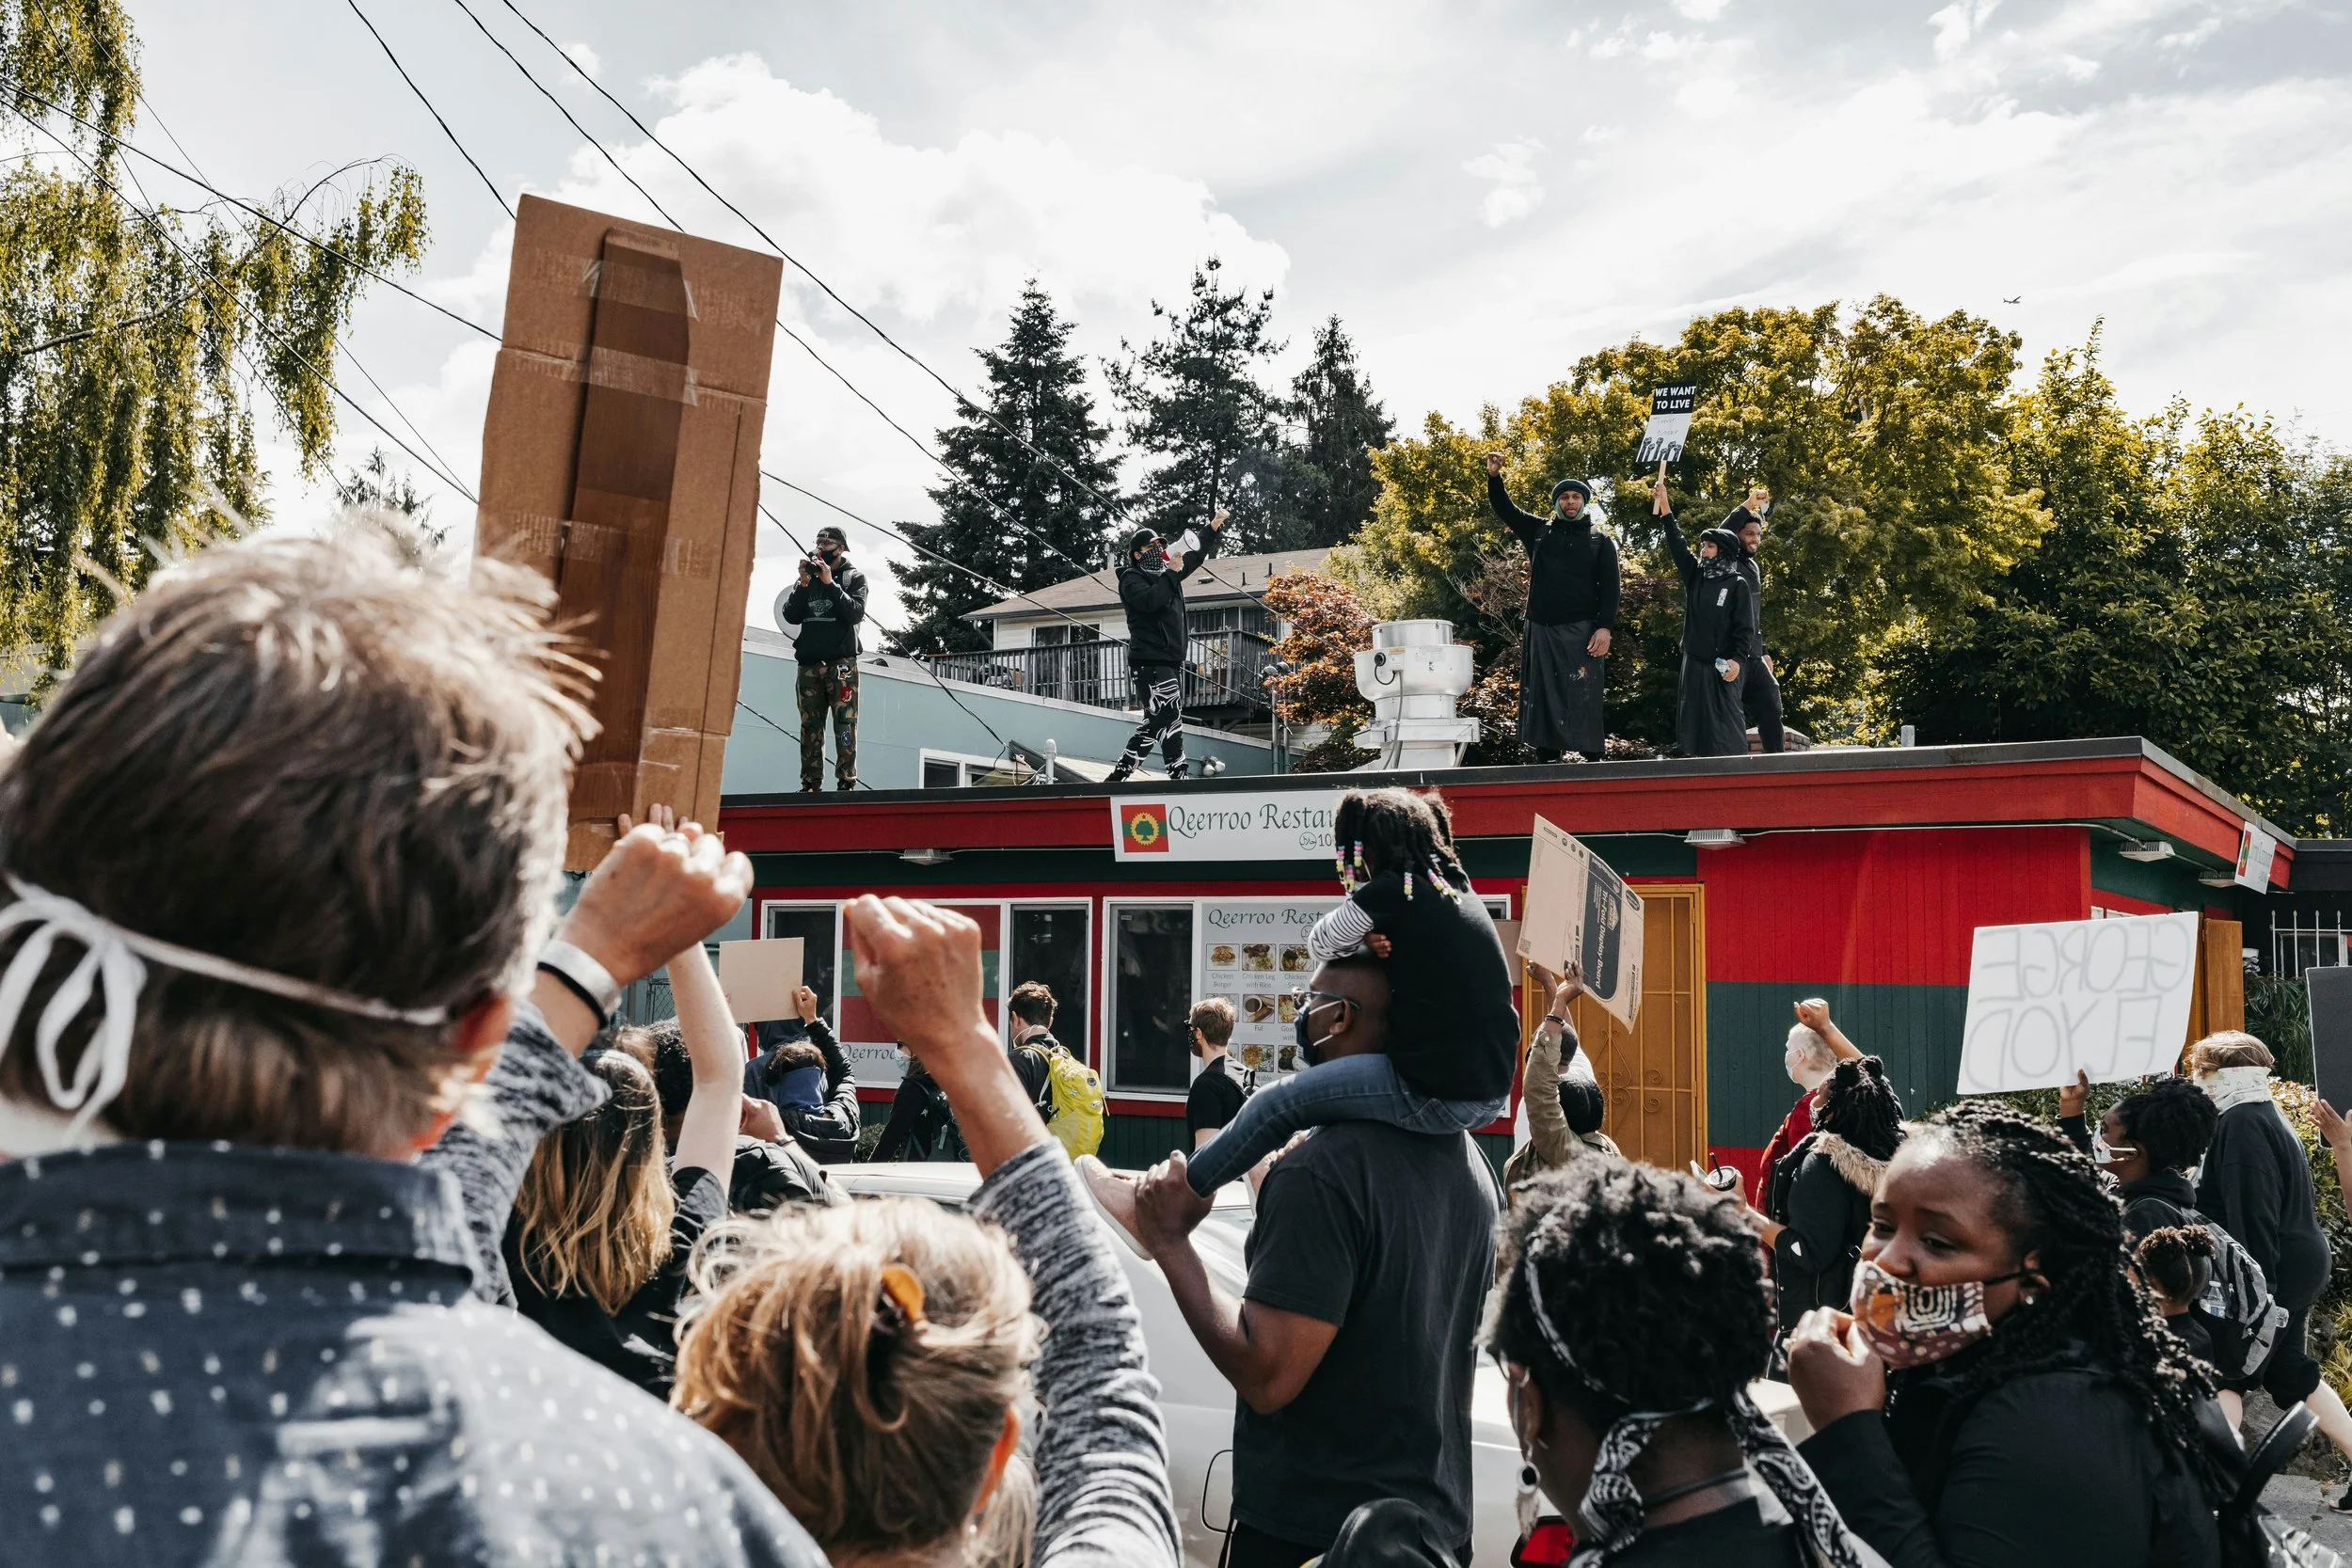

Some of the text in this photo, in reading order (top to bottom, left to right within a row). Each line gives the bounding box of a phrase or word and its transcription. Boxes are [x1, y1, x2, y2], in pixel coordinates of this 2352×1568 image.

[1656, 386, 1696, 397] WE WANT
[1657, 399, 1691, 410] TO LIVE
[1168, 806, 1251, 839] Qeerroo
[1208, 909, 1275, 929] Qeerroo
[1597, 925, 1606, 958] Display
[1595, 958, 1603, 990] Board
